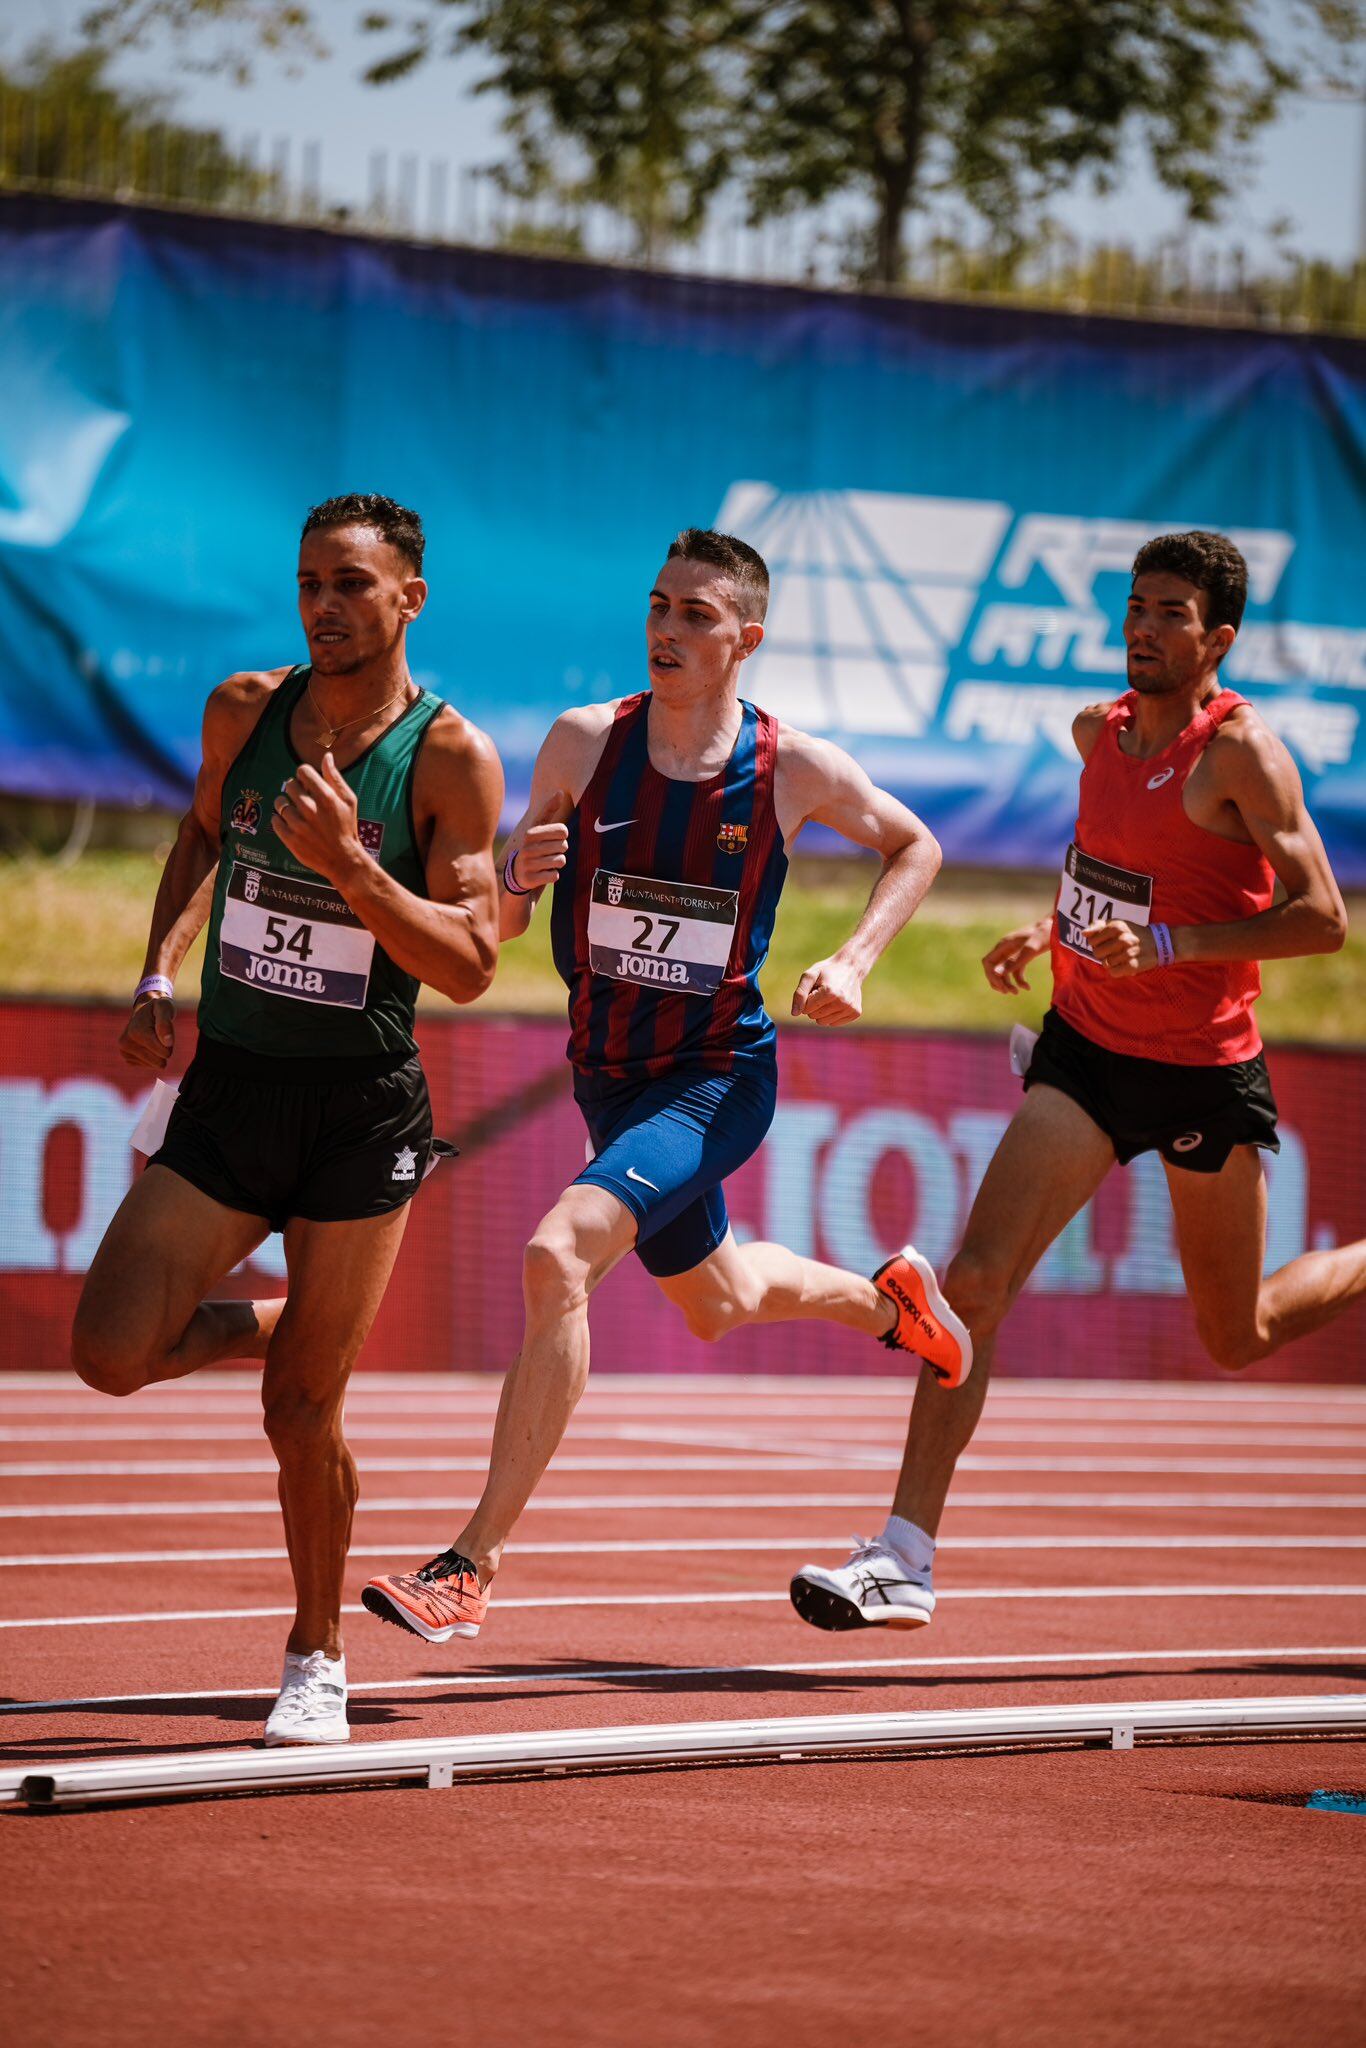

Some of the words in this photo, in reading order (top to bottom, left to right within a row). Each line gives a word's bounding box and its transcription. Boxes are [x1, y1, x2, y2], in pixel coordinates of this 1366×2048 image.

[316, 899, 356, 915] TORREN
[623, 888, 676, 904] AJUNTAMENT
[679, 896, 722, 911] TORRENT
[1070, 886, 1114, 925] 214
[263, 916, 313, 962] 54
[631, 915, 680, 954] 27
[886, 1277, 922, 1325] balance
[919, 1318, 937, 1340] new
